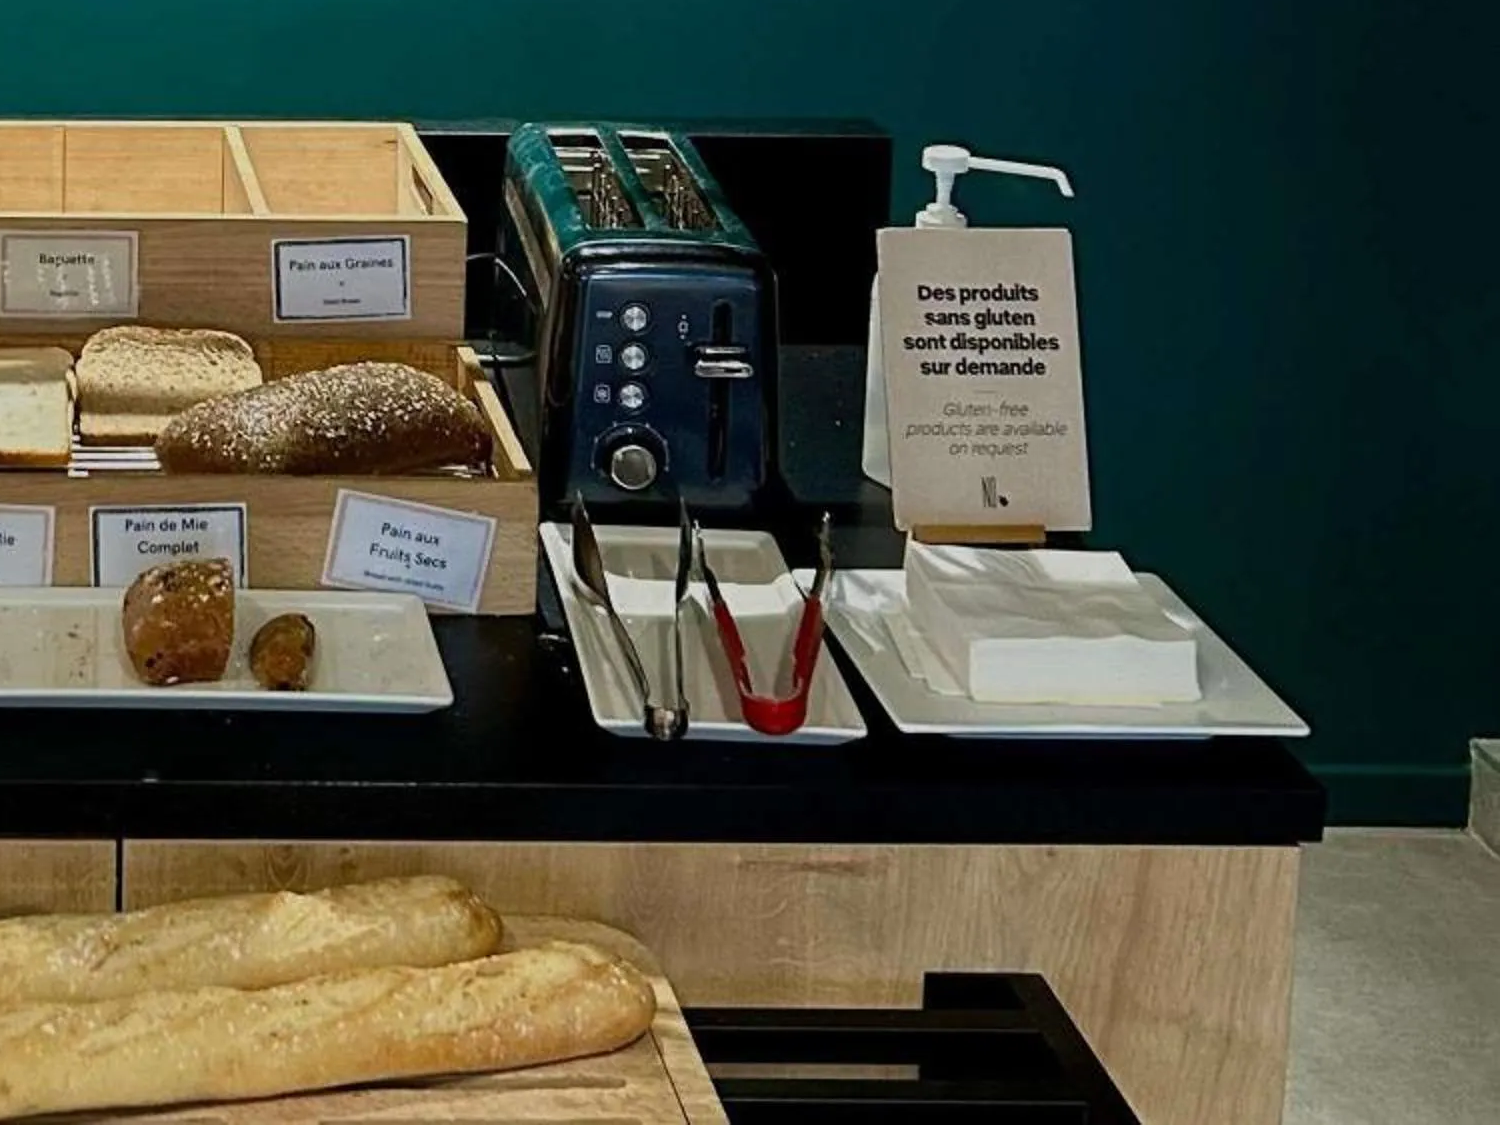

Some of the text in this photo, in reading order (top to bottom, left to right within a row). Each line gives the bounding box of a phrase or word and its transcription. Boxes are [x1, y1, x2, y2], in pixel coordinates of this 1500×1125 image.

[288, 258, 393, 272] Pain aux Graines
[917, 283, 1039, 305] Des produits
[924, 308, 1036, 330] sans gluten
[903, 332, 1060, 355] sont disponibles
[920, 356, 1047, 375] sur demande
[942, 400, 1029, 418] Gluten-free
[904, 420, 1069, 441] products are available
[949, 442, 1030, 461] on request
[125, 517, 210, 533] Pain de Mie
[381, 522, 441, 547] Pain aux
[136, 540, 200, 557] Complet
[369, 542, 448, 570] Fruits Secs
